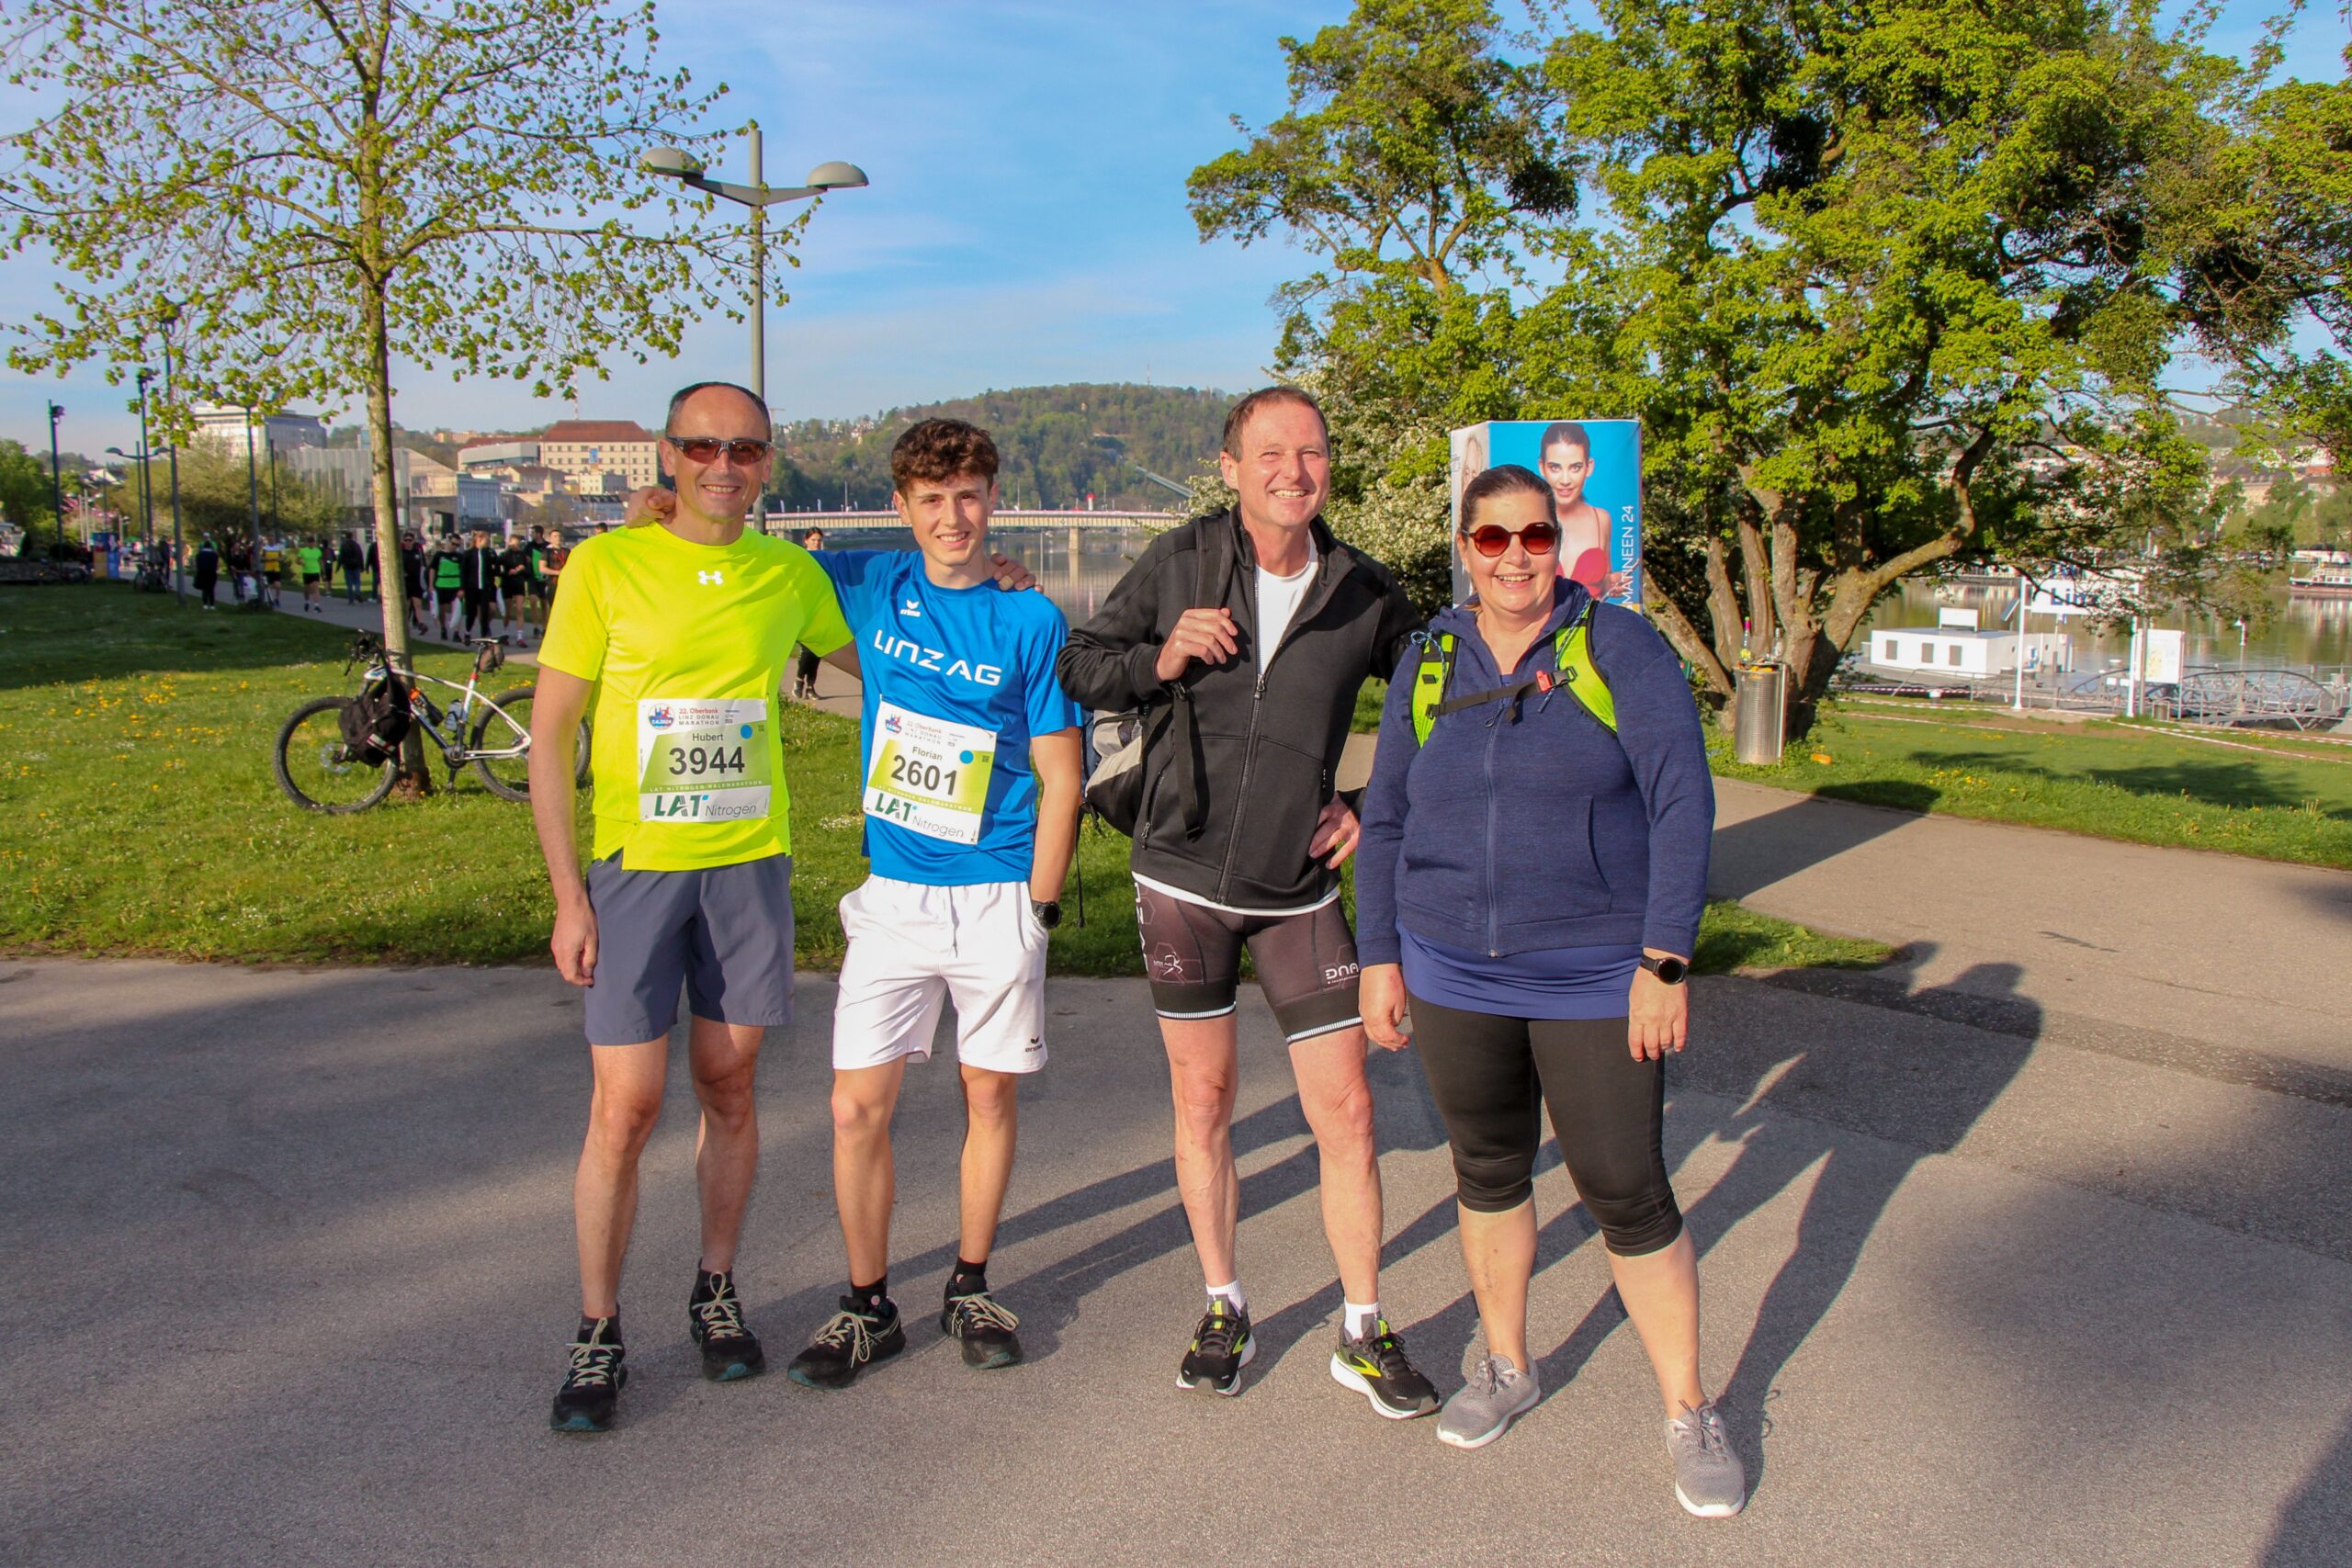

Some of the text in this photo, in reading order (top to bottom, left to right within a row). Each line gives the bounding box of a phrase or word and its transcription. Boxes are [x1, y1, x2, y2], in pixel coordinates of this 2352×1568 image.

[1621, 505, 1634, 523] 24
[945, 660, 1001, 686] AG
[692, 733, 724, 741] Hubert
[668, 746, 745, 775] 3944
[912, 746, 943, 761] Florian
[891, 754, 957, 795] 2601
[654, 795, 756, 818] LAT Nitrogen
[875, 793, 965, 838] LAT Nitrogen
[1325, 963, 1359, 979] DNA
